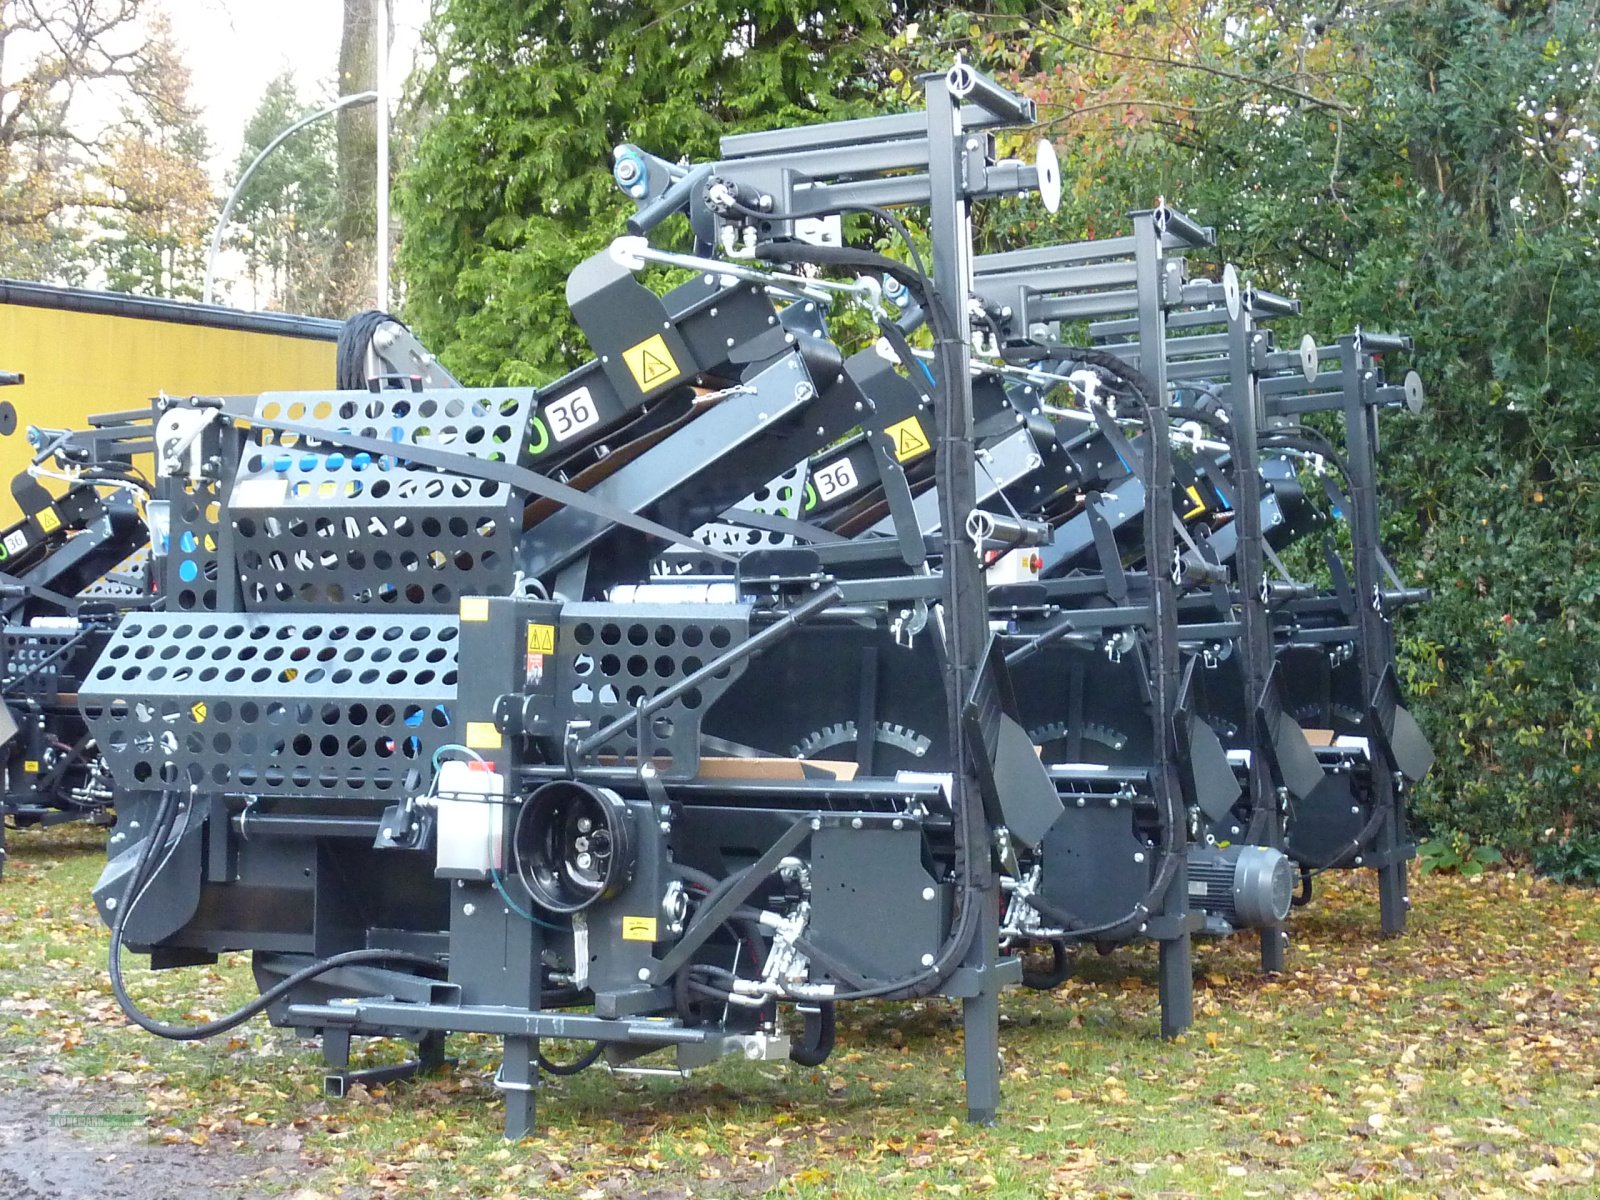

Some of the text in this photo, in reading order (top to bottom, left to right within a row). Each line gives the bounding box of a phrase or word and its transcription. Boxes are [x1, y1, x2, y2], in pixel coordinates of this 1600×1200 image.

[552, 396, 590, 434] 36
[819, 465, 850, 495] 36
[7, 534, 23, 551] 36
